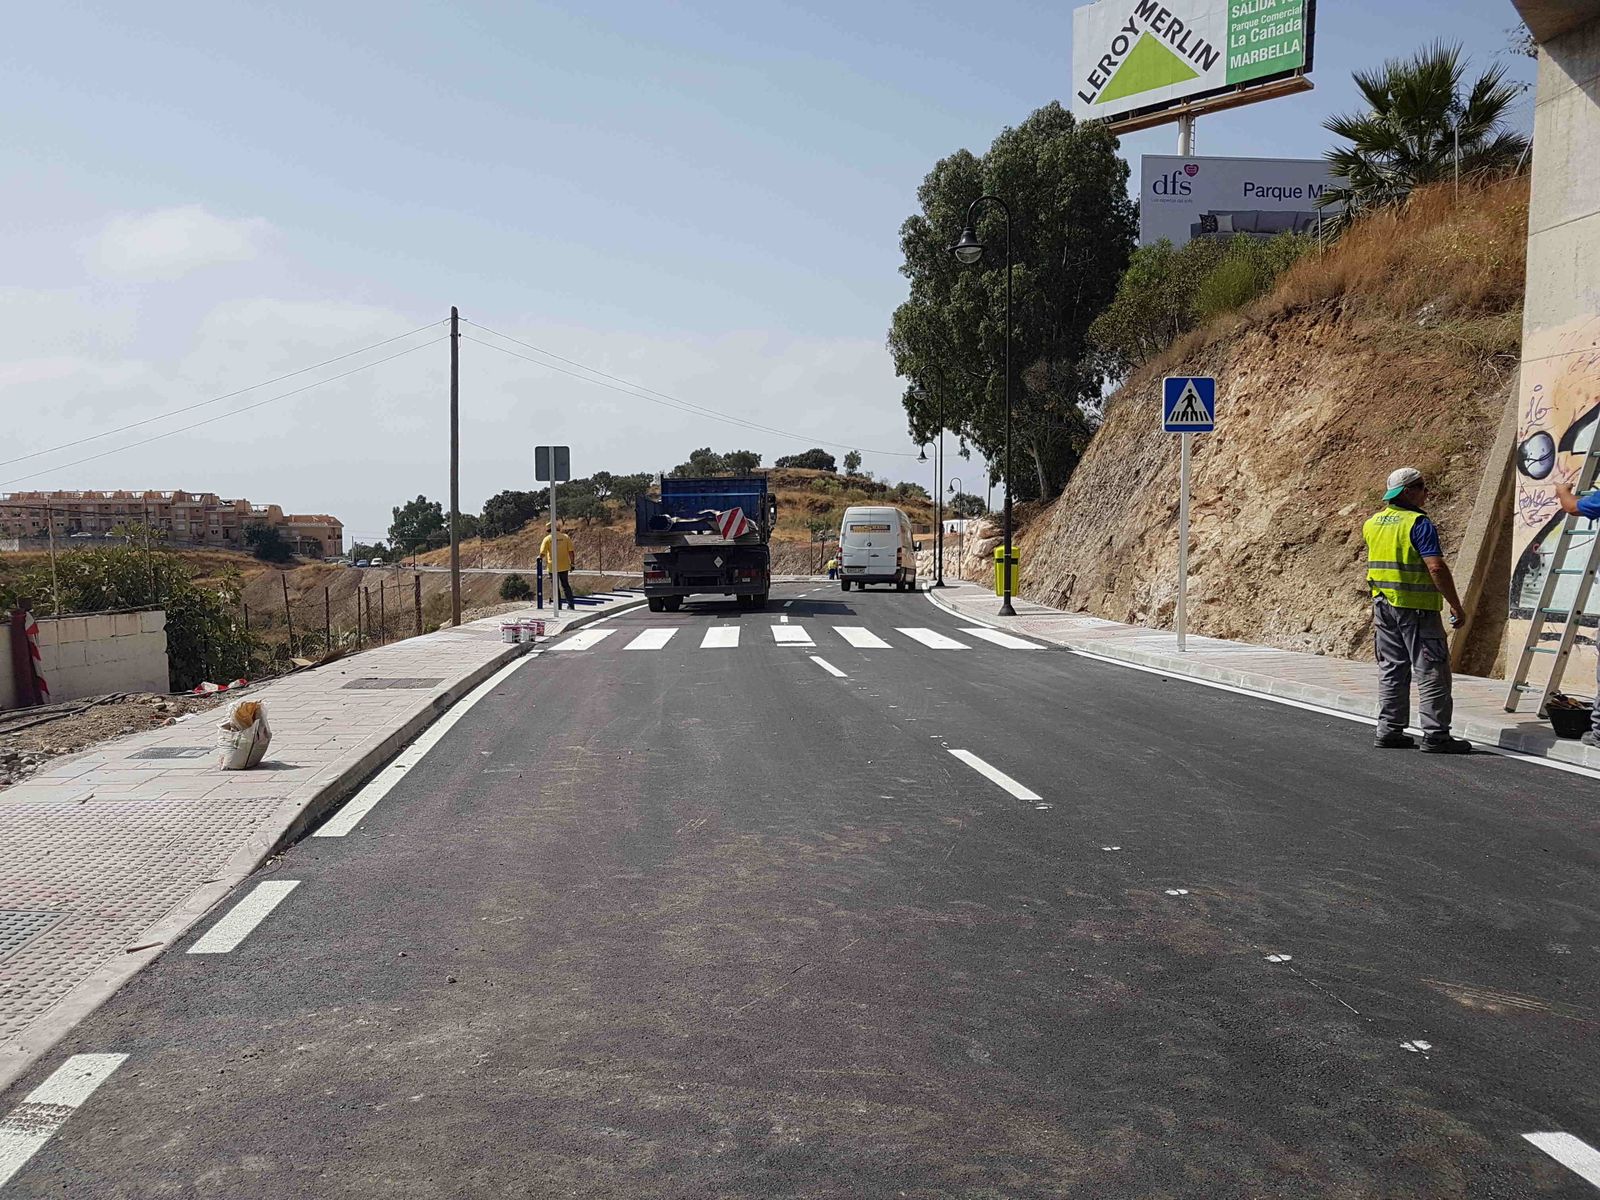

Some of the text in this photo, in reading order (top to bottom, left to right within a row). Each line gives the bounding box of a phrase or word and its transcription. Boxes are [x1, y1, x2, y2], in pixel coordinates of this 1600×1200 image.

[1231, 0, 1277, 18] SALIDA
[1231, 4, 1302, 33] Parque Comercial
[1133, 0, 1221, 73] MERLIN
[1231, 17, 1302, 49] La Cañada
[1077, 15, 1140, 105] LEROY
[1230, 38, 1300, 70] MARBELLA
[1152, 170, 1192, 196] dfs
[1243, 182, 1303, 202] Parque
